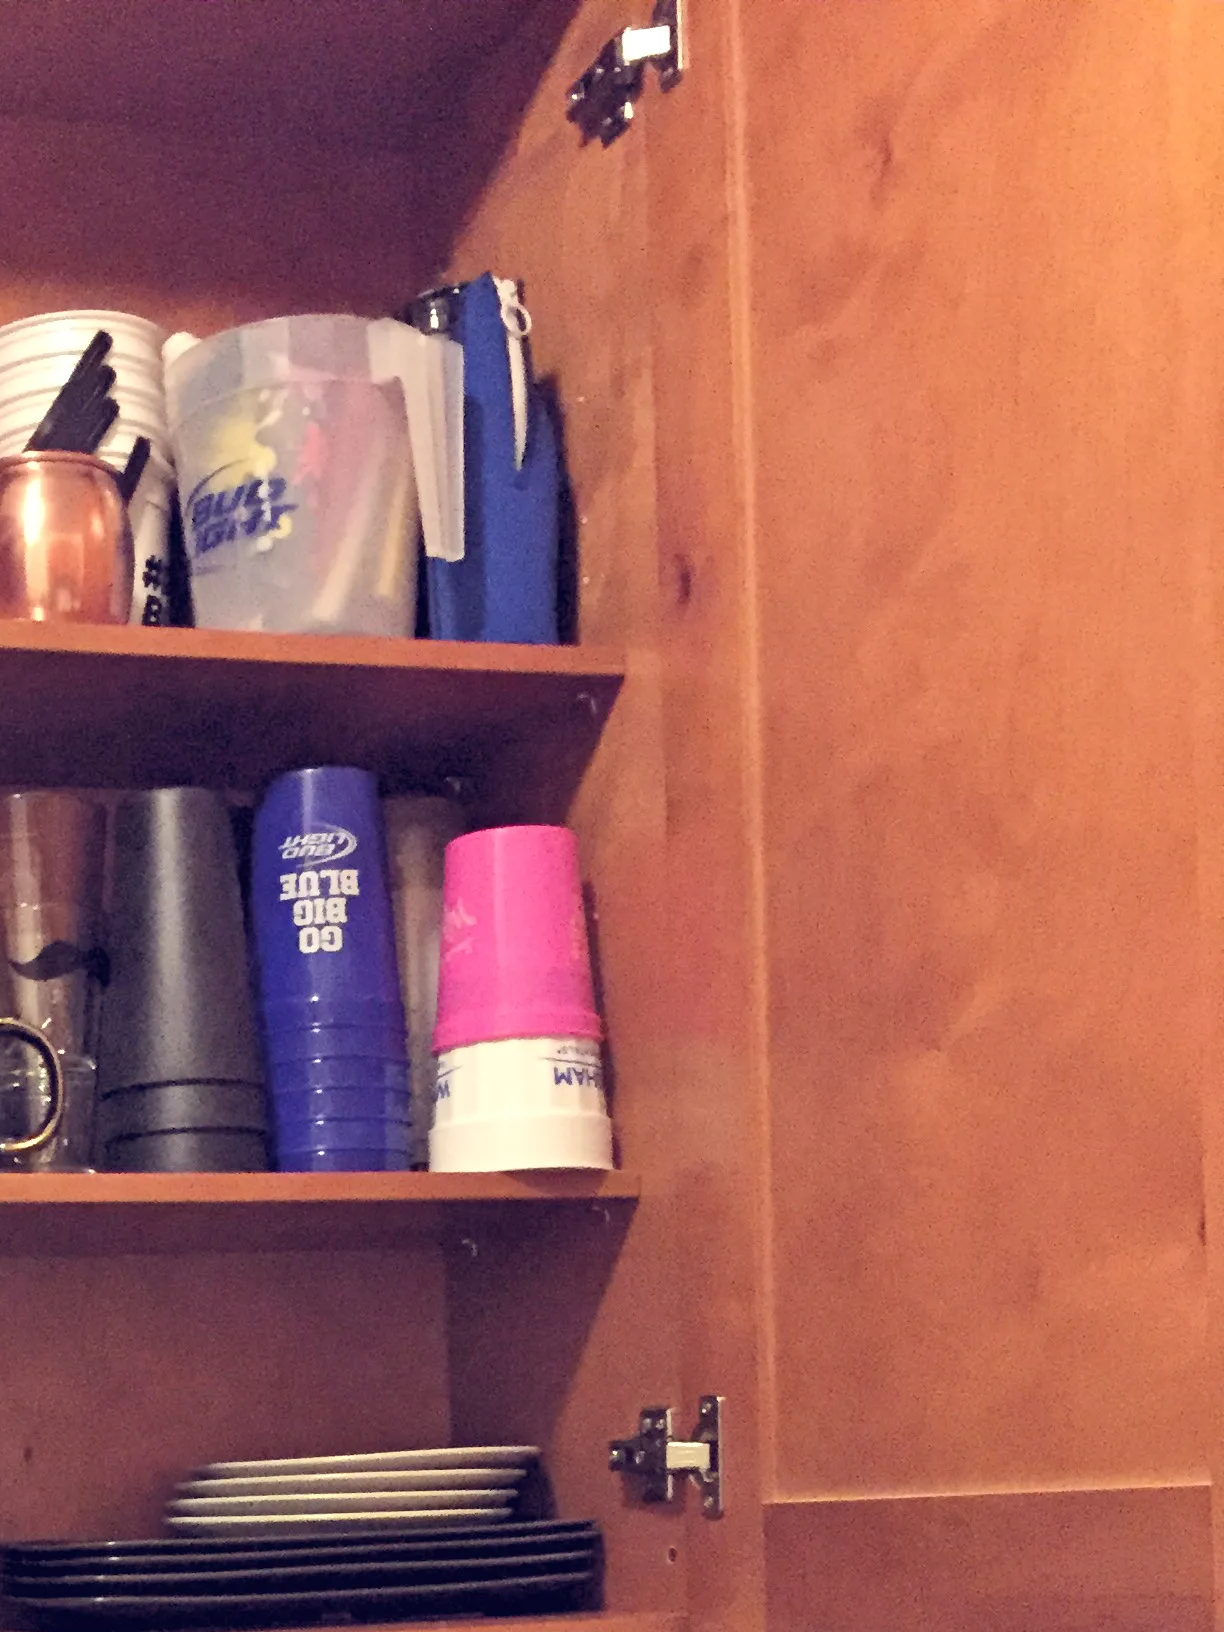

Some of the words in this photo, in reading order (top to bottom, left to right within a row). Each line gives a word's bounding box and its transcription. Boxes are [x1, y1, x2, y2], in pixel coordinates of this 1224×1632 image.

[278, 832, 350, 850] LIGHT
[281, 843, 336, 859] BUD
[279, 868, 360, 901] BLUE
[293, 896, 348, 926] BIG
[298, 925, 343, 954] GO
